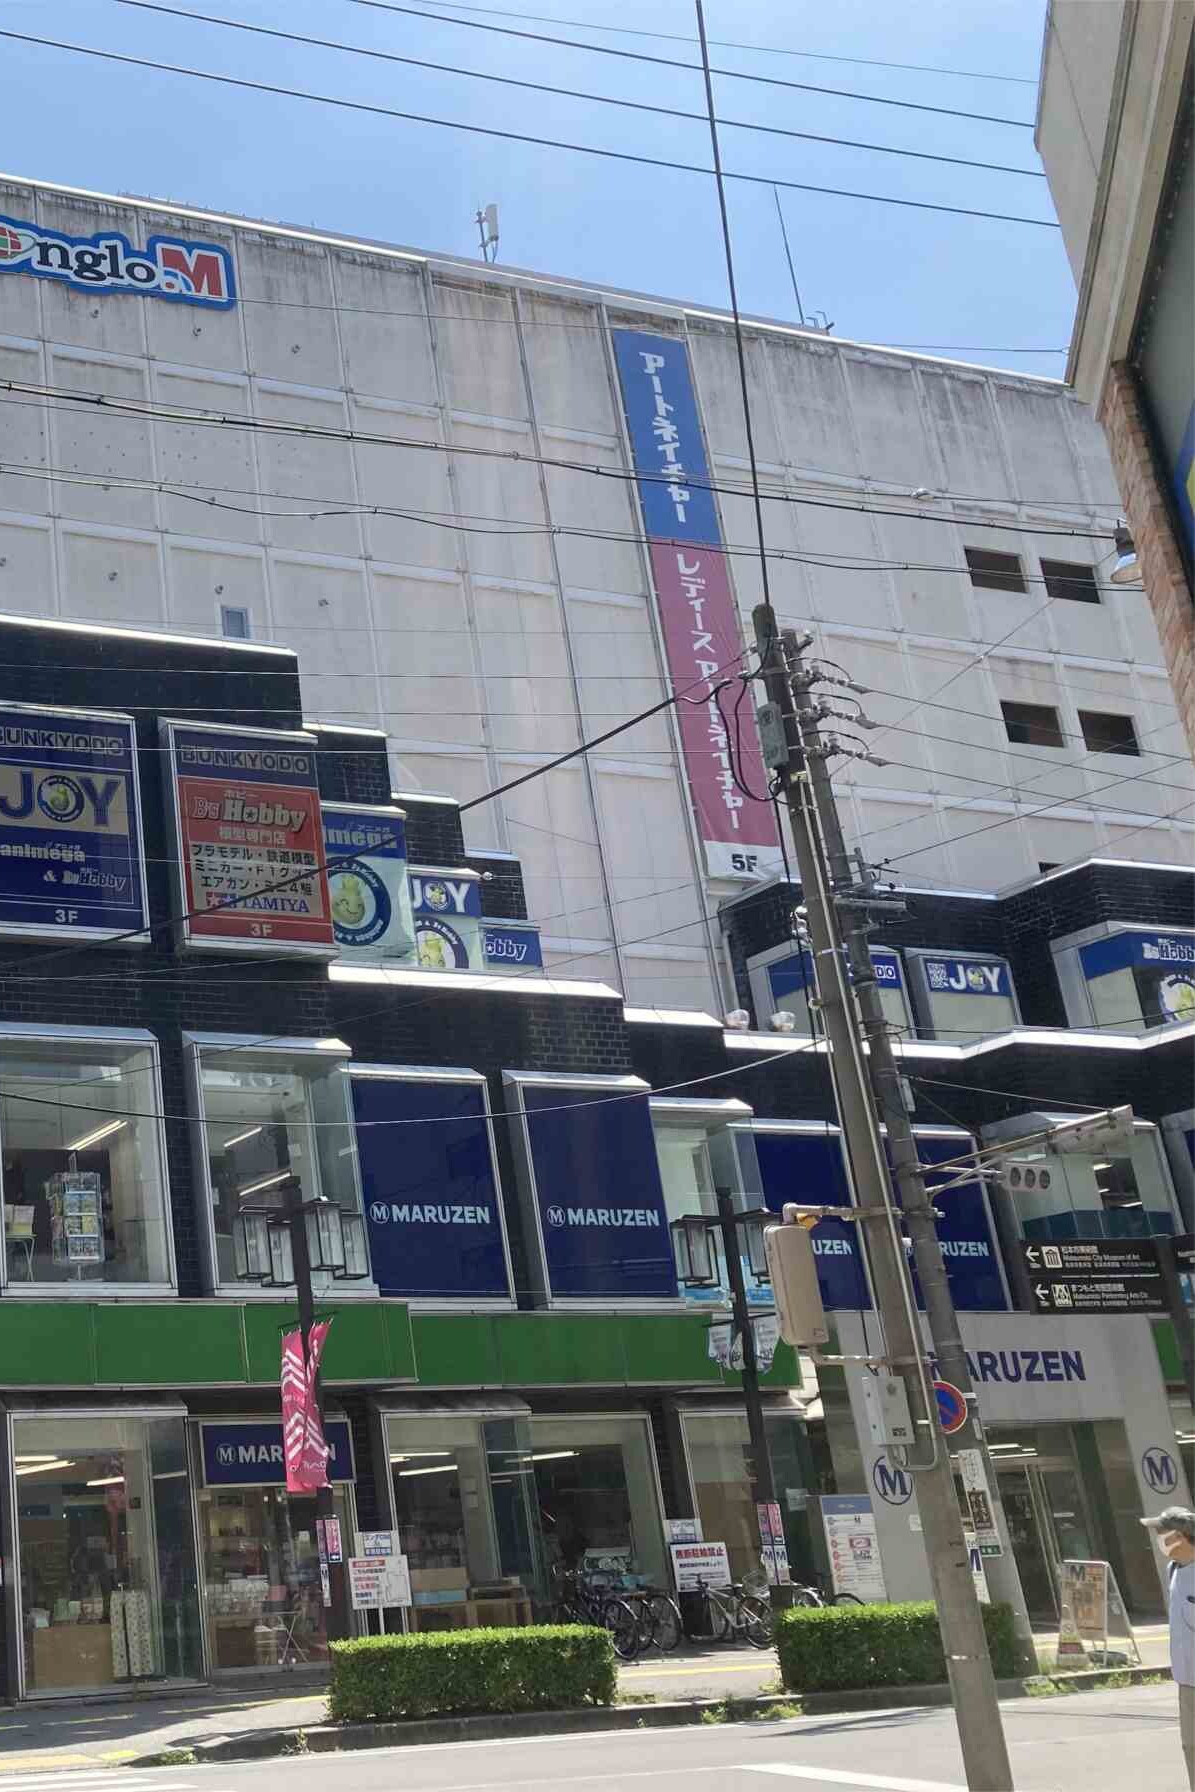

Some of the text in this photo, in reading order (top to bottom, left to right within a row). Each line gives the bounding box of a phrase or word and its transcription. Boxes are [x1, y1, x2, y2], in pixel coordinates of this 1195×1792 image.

[639, 351, 691, 523] アートネイチャー
[181, 747, 310, 774] BUNKYODO
[223, 799, 307, 833] Hobby
[0, 842, 86, 864] animega
[731, 853, 758, 873] 5F
[412, 878, 471, 913] JOY
[55, 909, 79, 923] 3F
[250, 922, 273, 937] 3F
[484, 937, 527, 961] obby
[949, 963, 1001, 993] JOY
[391, 1204, 491, 1225] MARUZEN
[567, 1208, 660, 1228] MARUZEN
[811, 1239, 853, 1256] UZEN
[939, 1241, 990, 1257] RUZEN
